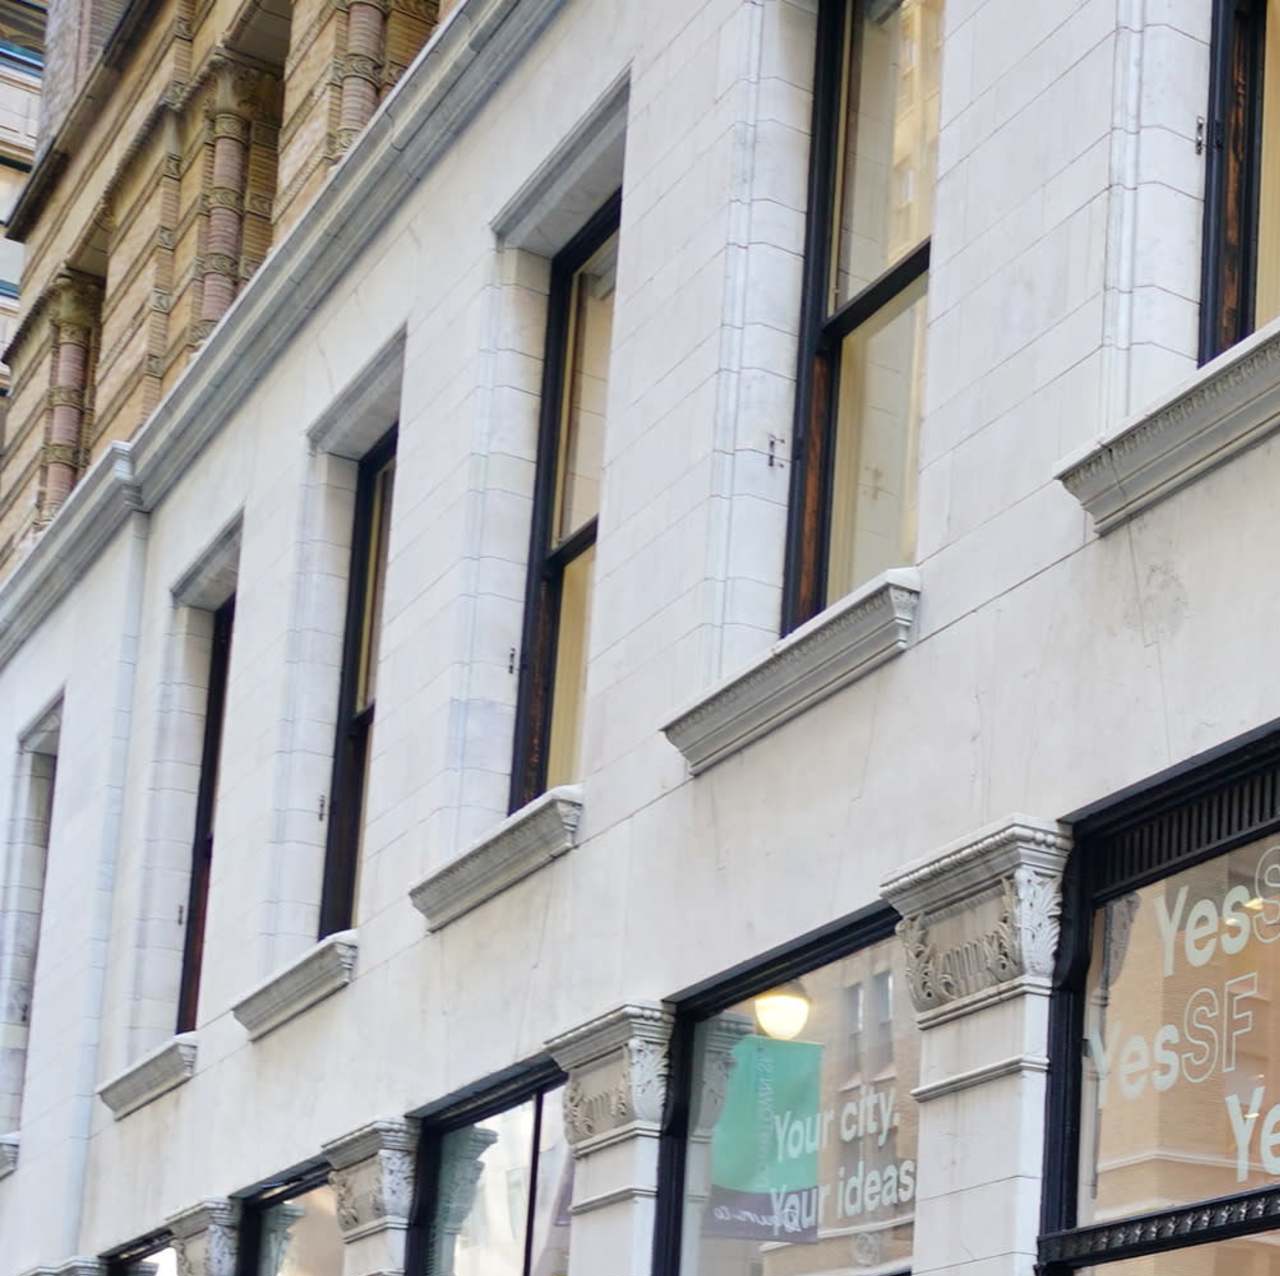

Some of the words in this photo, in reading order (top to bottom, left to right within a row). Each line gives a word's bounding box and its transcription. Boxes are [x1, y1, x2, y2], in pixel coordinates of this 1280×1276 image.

[773, 1109, 834, 1163] Your
[840, 1083, 900, 1147] city.
[770, 1184, 831, 1237] Your
